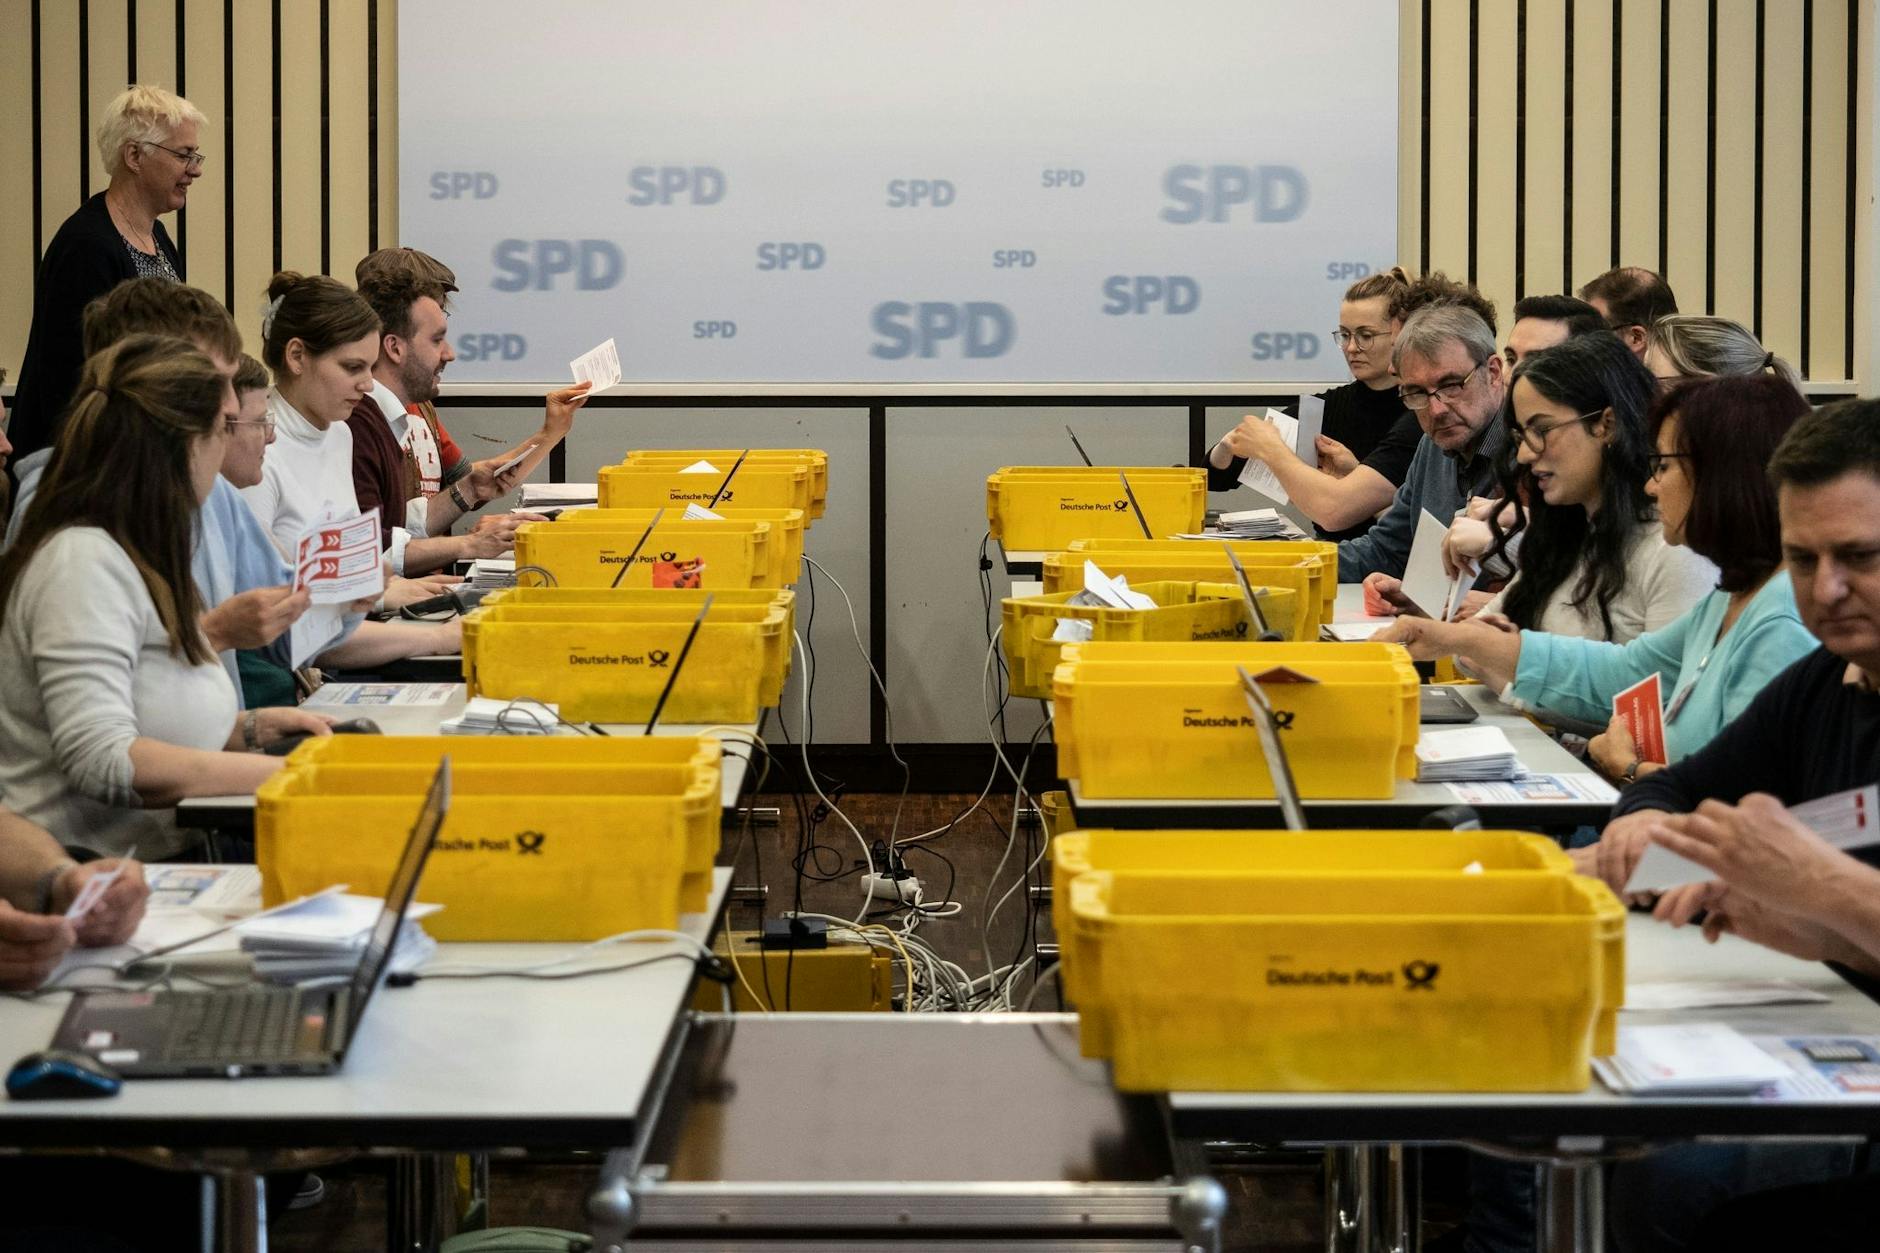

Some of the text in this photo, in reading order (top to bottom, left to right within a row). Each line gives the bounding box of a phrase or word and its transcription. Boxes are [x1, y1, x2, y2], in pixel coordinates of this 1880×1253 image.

[429, 171, 499, 200] SPD
[627, 166, 727, 206] SPD
[1041, 170, 1085, 188] SPD
[886, 179, 956, 208] SPD
[1160, 165, 1311, 224] SPD
[490, 238, 625, 292] SPD
[756, 242, 826, 271] SPD
[992, 250, 1037, 268] SPD
[1327, 262, 1370, 281] SPD
[1102, 276, 1200, 316] SPD
[693, 321, 737, 339] SPD
[868, 301, 1017, 360] SPD
[457, 333, 527, 362] SPD
[1252, 331, 1321, 360] SPD
[670, 492, 702, 500] Deutsche
[1060, 503, 1111, 511] Deutsche Post
[640, 555, 657, 563] Post
[570, 654, 644, 665] Deutsche Post
[1183, 716, 1255, 727] Deutsche Po
[479, 838, 510, 850] Post
[1266, 968, 1395, 986] Deutsche Post
